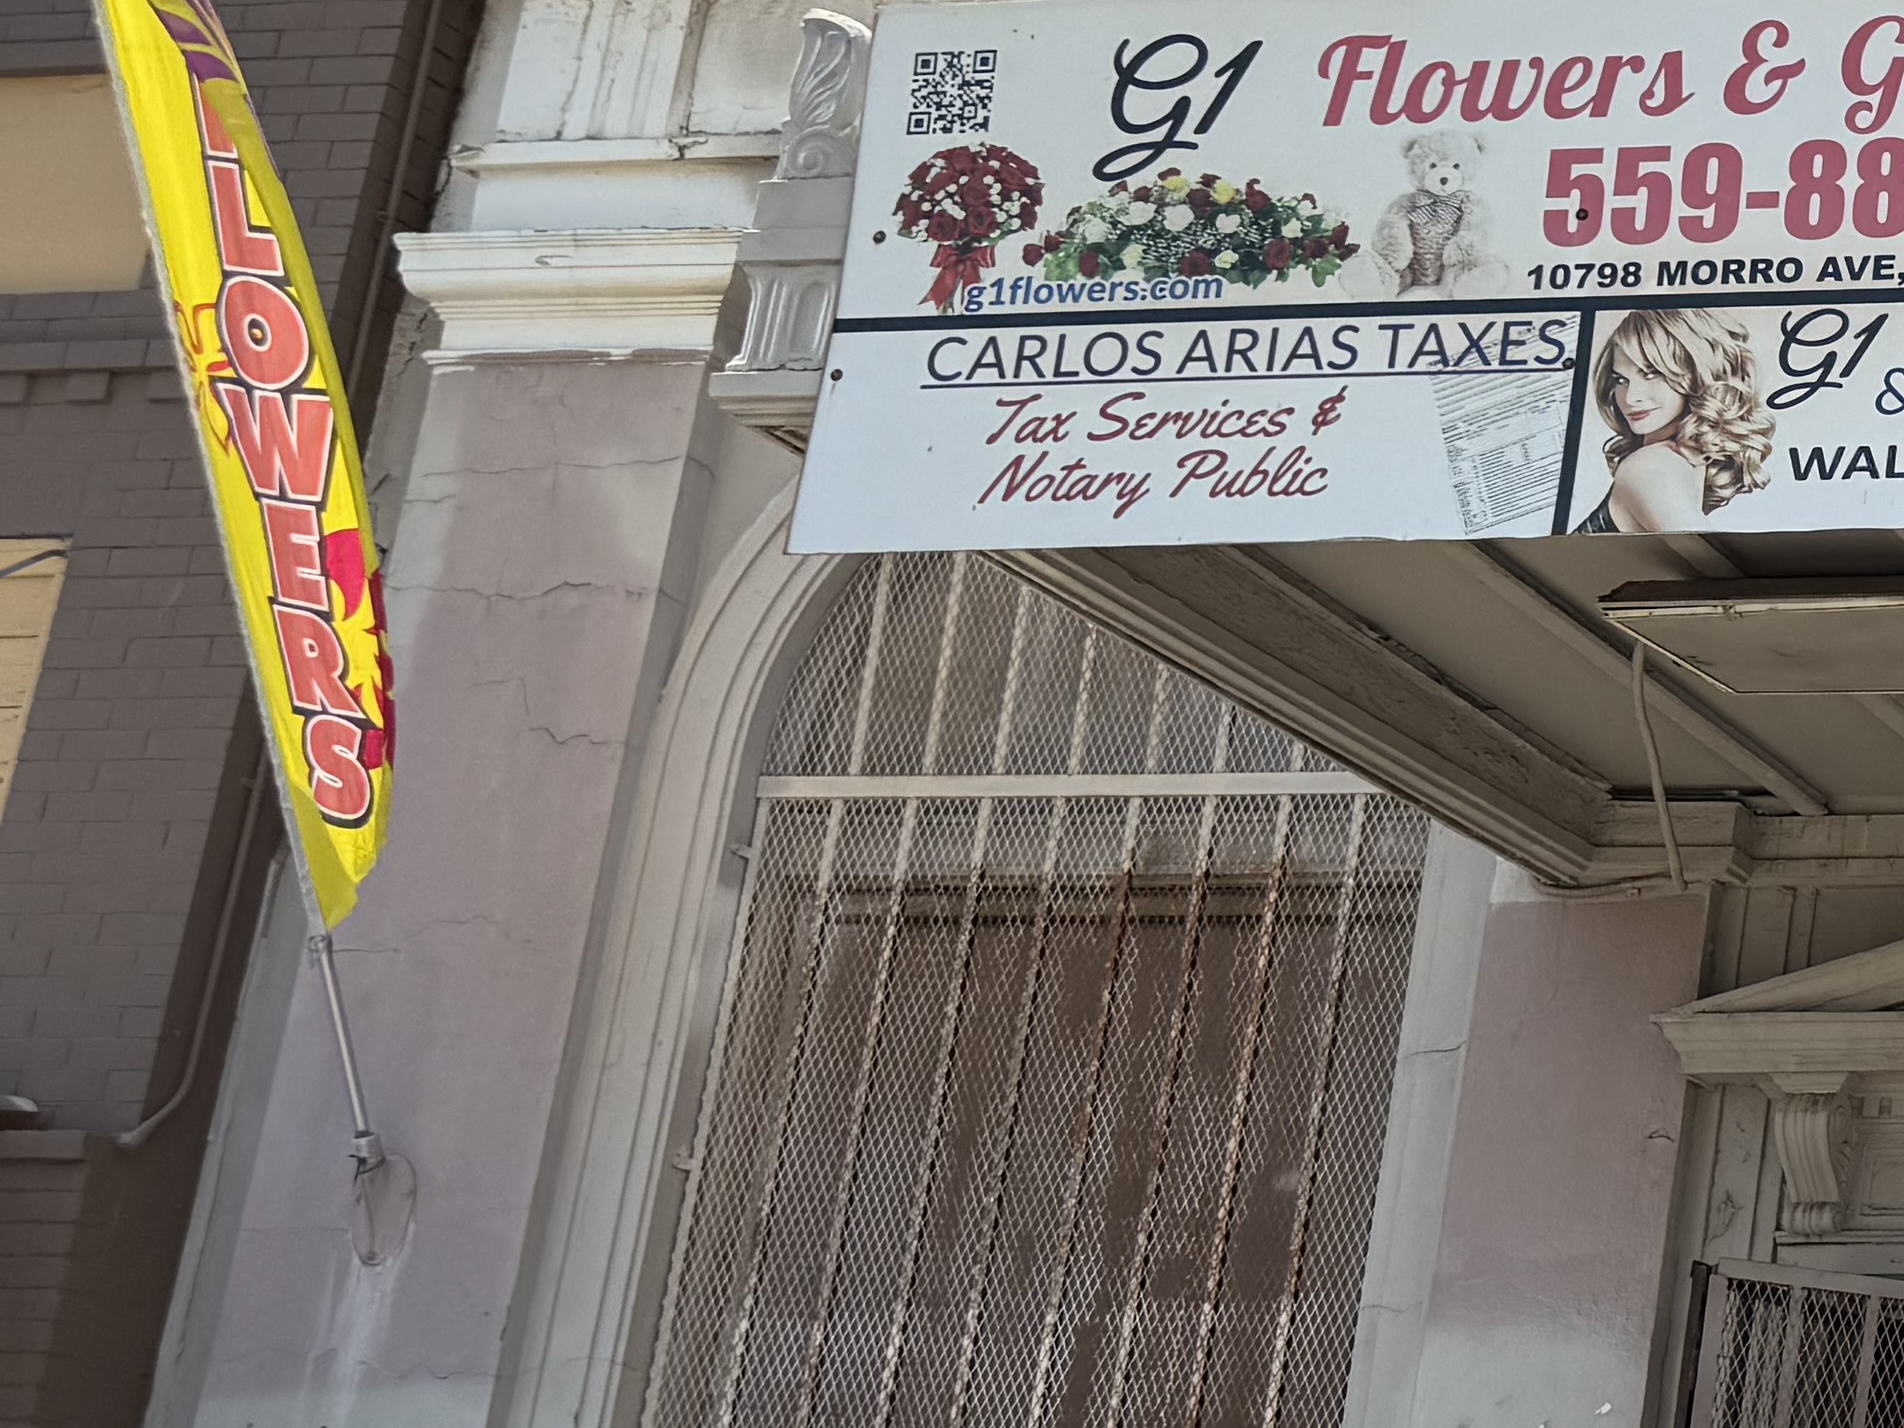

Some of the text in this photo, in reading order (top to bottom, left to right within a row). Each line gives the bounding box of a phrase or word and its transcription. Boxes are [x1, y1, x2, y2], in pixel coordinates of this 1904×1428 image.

[1091, 32, 1264, 182] G1
[1317, 33, 1696, 128] Flowers
[1722, 19, 1806, 116] &
[962, 274, 1224, 312] g1flowers.com
[1527, 261, 1643, 291] 10798
[1656, 256, 1804, 287] MORRO
[927, 318, 1568, 382] CARLOS ARIAS TAXES
[1766, 308, 1890, 410] G1
[985, 385, 1348, 446] Tax Services &
[976, 445, 1329, 519] Notary Public
